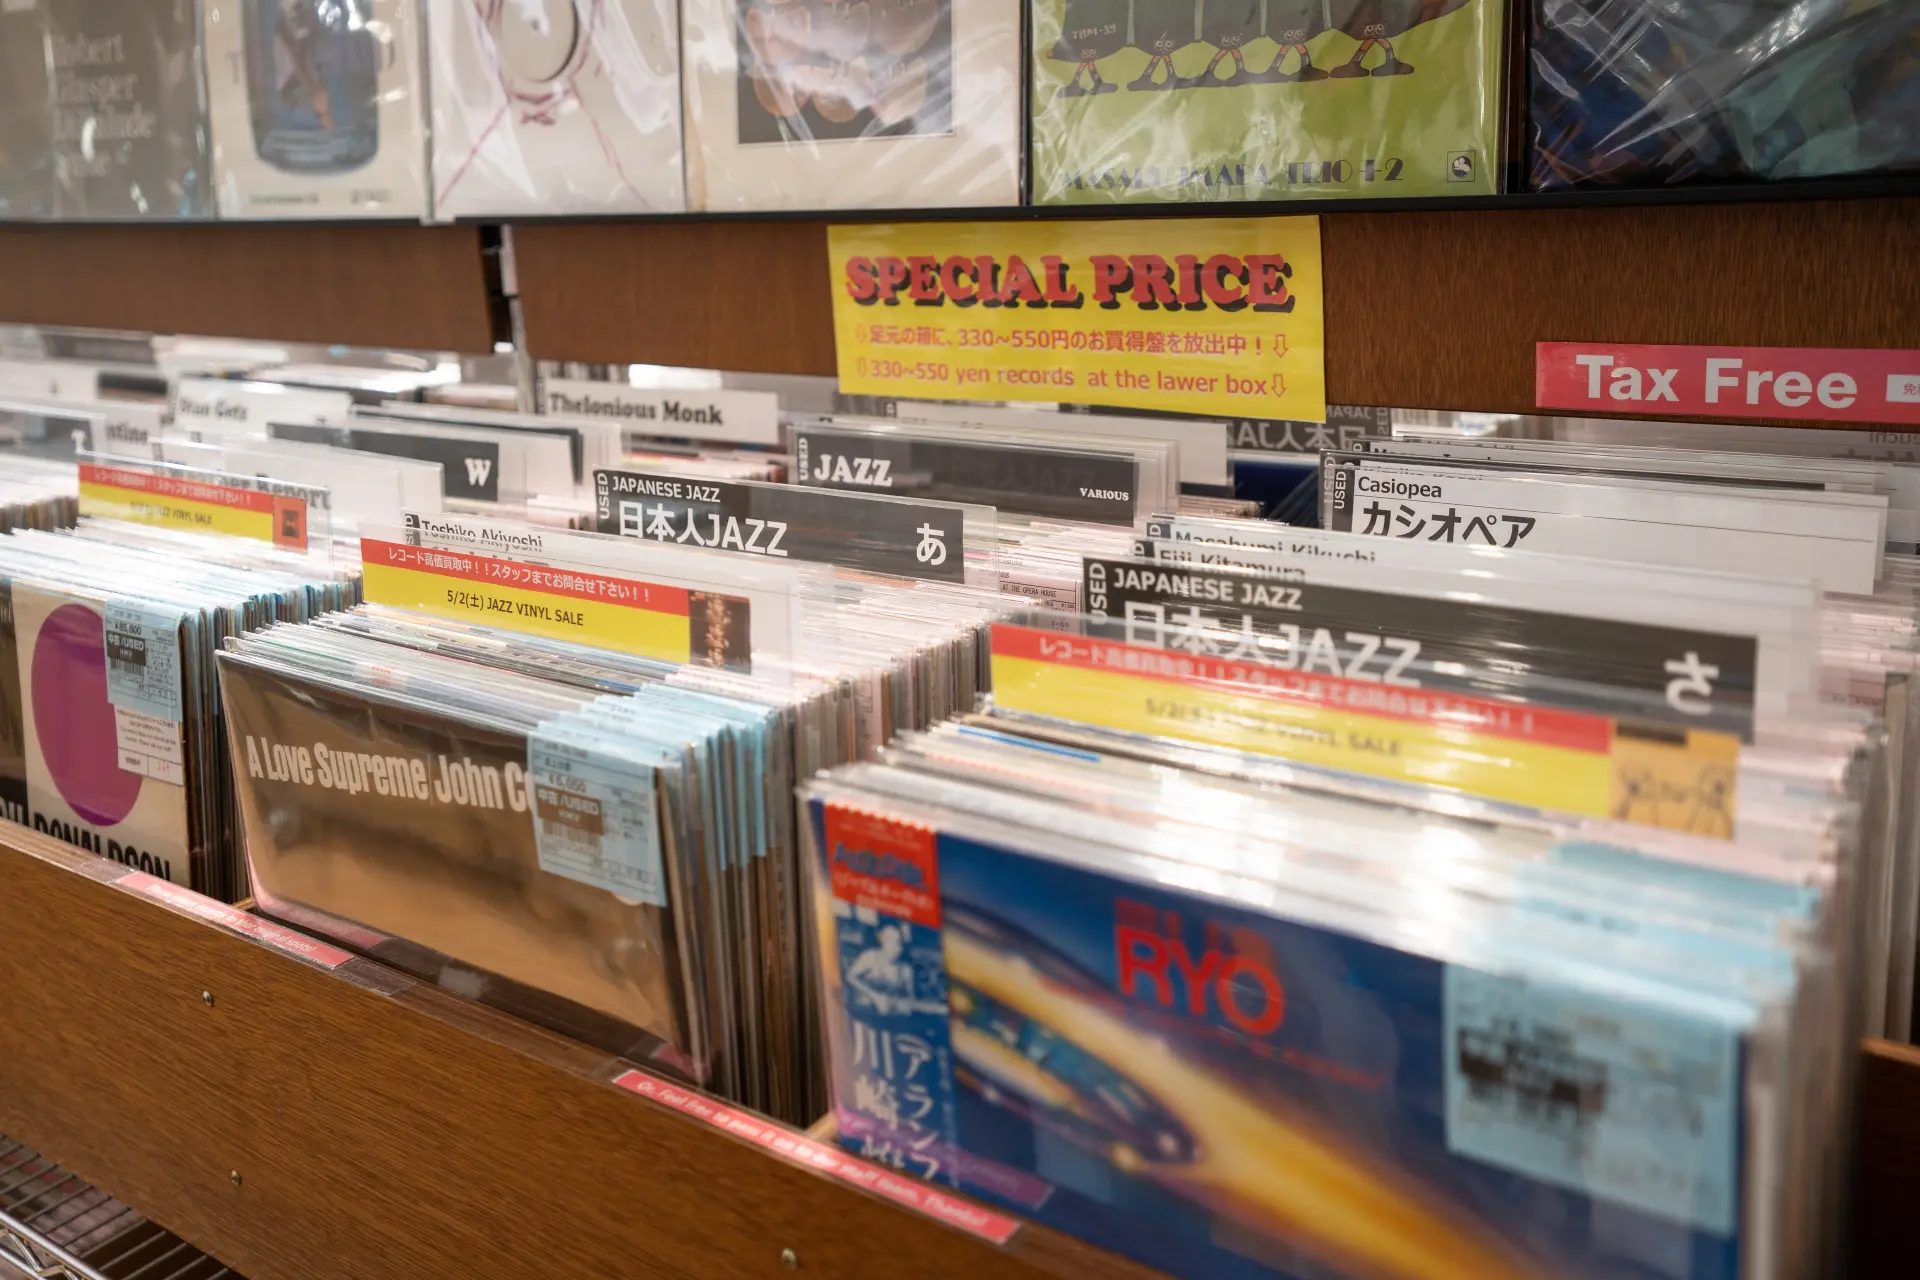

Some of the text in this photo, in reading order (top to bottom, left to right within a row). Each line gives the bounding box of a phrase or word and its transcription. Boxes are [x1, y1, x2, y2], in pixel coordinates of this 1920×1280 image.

[1284, 159, 1352, 185] TRIO
[846, 253, 1296, 314] SPECIAL PRICE
[955, 367, 990, 385] yen
[997, 367, 1075, 386] records
[1088, 369, 1108, 388] at
[1115, 370, 1150, 390] the
[1157, 370, 1219, 395] lawer
[1226, 374, 1268, 396] box
[1576, 354, 1858, 408] Tax Free
[550, 393, 656, 419] Thelonious
[662, 400, 722, 425] Monk
[464, 458, 492, 488] W
[797, 437, 809, 480] USED
[813, 454, 893, 487] JAZZ
[598, 473, 609, 520] USED
[612, 476, 721, 502] JAPANESE JAZZ
[1079, 487, 1130, 502] VARIOUS
[1334, 471, 1347, 510] USED
[1358, 476, 1442, 499] Casiopea
[421, 520, 543, 552] Toshiko Akiyoshi
[619, 501, 788, 556] 日本人JAZZ
[916, 523, 946, 565] あ
[1361, 501, 1536, 548] カシオペア
[447, 589, 584, 626] 5/2(土) JAZZ VINYL SALE
[1011, 585, 1021, 593] THE
[1022, 587, 1039, 595] OPERA
[1040, 590, 1057, 598] HOUSE
[1089, 562, 1107, 625] USED
[1113, 567, 1303, 610] JAPANESE JAZZ
[1125, 601, 1421, 688] 日本人JAZZ
[1664, 651, 1719, 714] さ
[246, 735, 264, 779] A
[261, 737, 315, 786] Love
[314, 742, 430, 801] Supreme
[434, 755, 505, 810] John
[1115, 925, 1285, 1035] RYO
